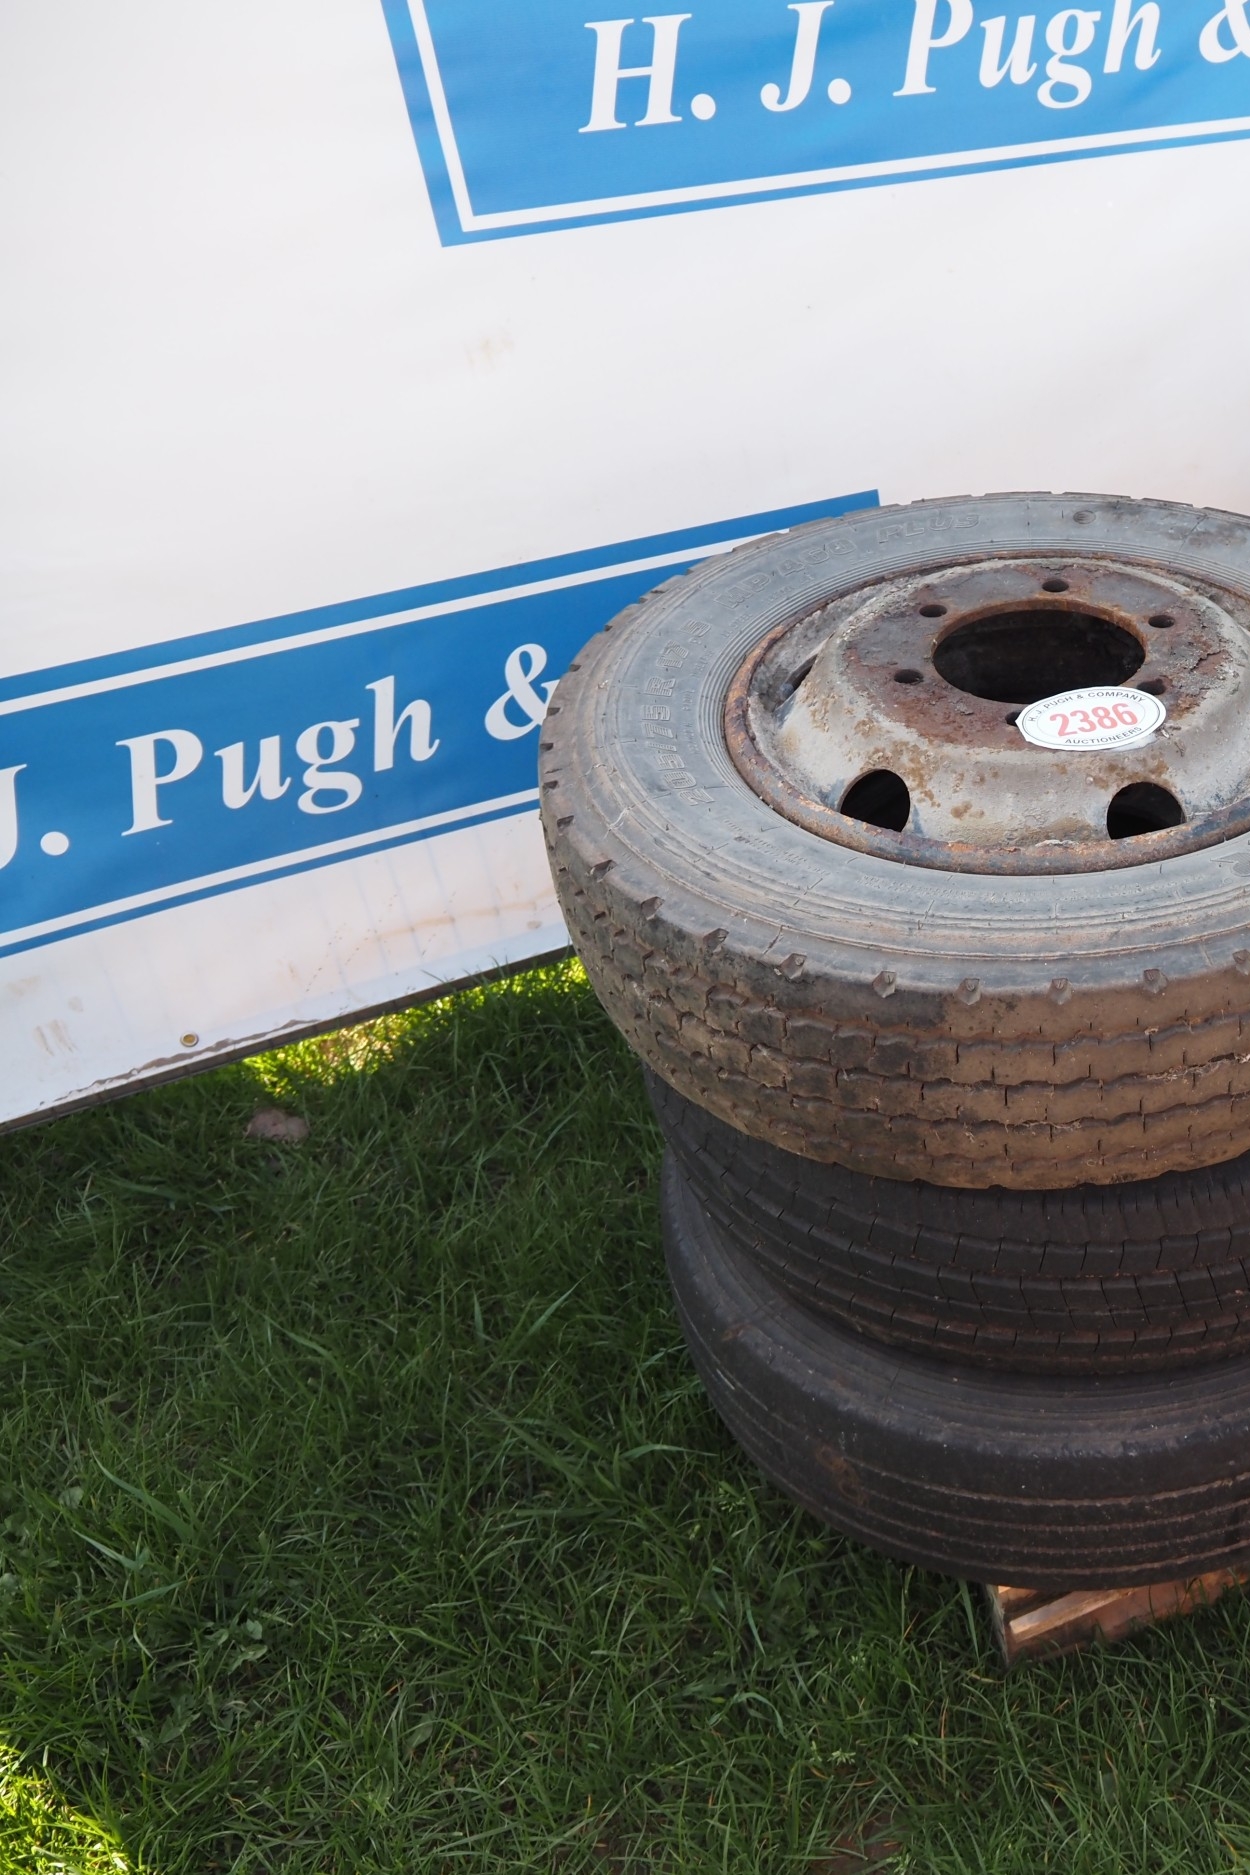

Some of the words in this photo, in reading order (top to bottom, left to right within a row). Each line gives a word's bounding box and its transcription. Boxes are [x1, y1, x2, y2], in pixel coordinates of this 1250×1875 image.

[579, 14, 716, 133] H.
[760, 0, 851, 112] J.
[893, 0, 1161, 109] Pugh
[876, 510, 981, 543] PLUS
[1043, 696, 1073, 709] PUGH
[1088, 691, 1146, 703] COMPANY
[1050, 702, 1138, 737] 2386
[1065, 726, 1142, 744] AUCTIONEERS
[117, 676, 439, 835] Pugh
[485, 644, 561, 740] &
